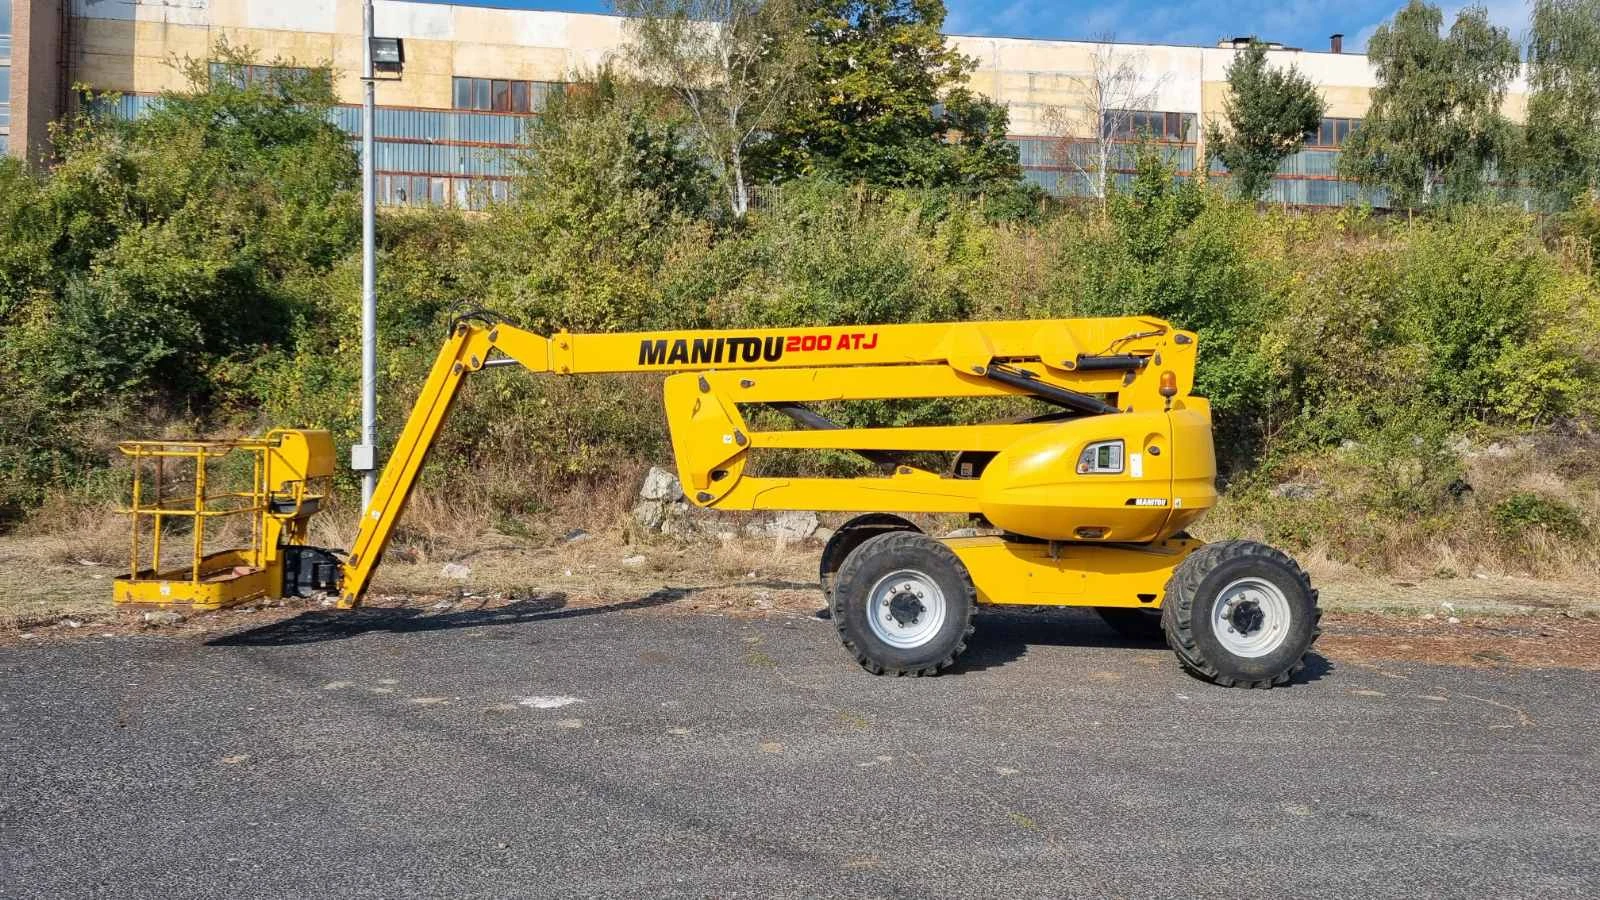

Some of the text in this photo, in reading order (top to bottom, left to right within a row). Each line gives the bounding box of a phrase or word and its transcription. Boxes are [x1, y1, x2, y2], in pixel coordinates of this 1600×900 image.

[638, 333, 878, 365] MANITOU 200 ATJ
[1135, 498, 1167, 506] MANITOU
